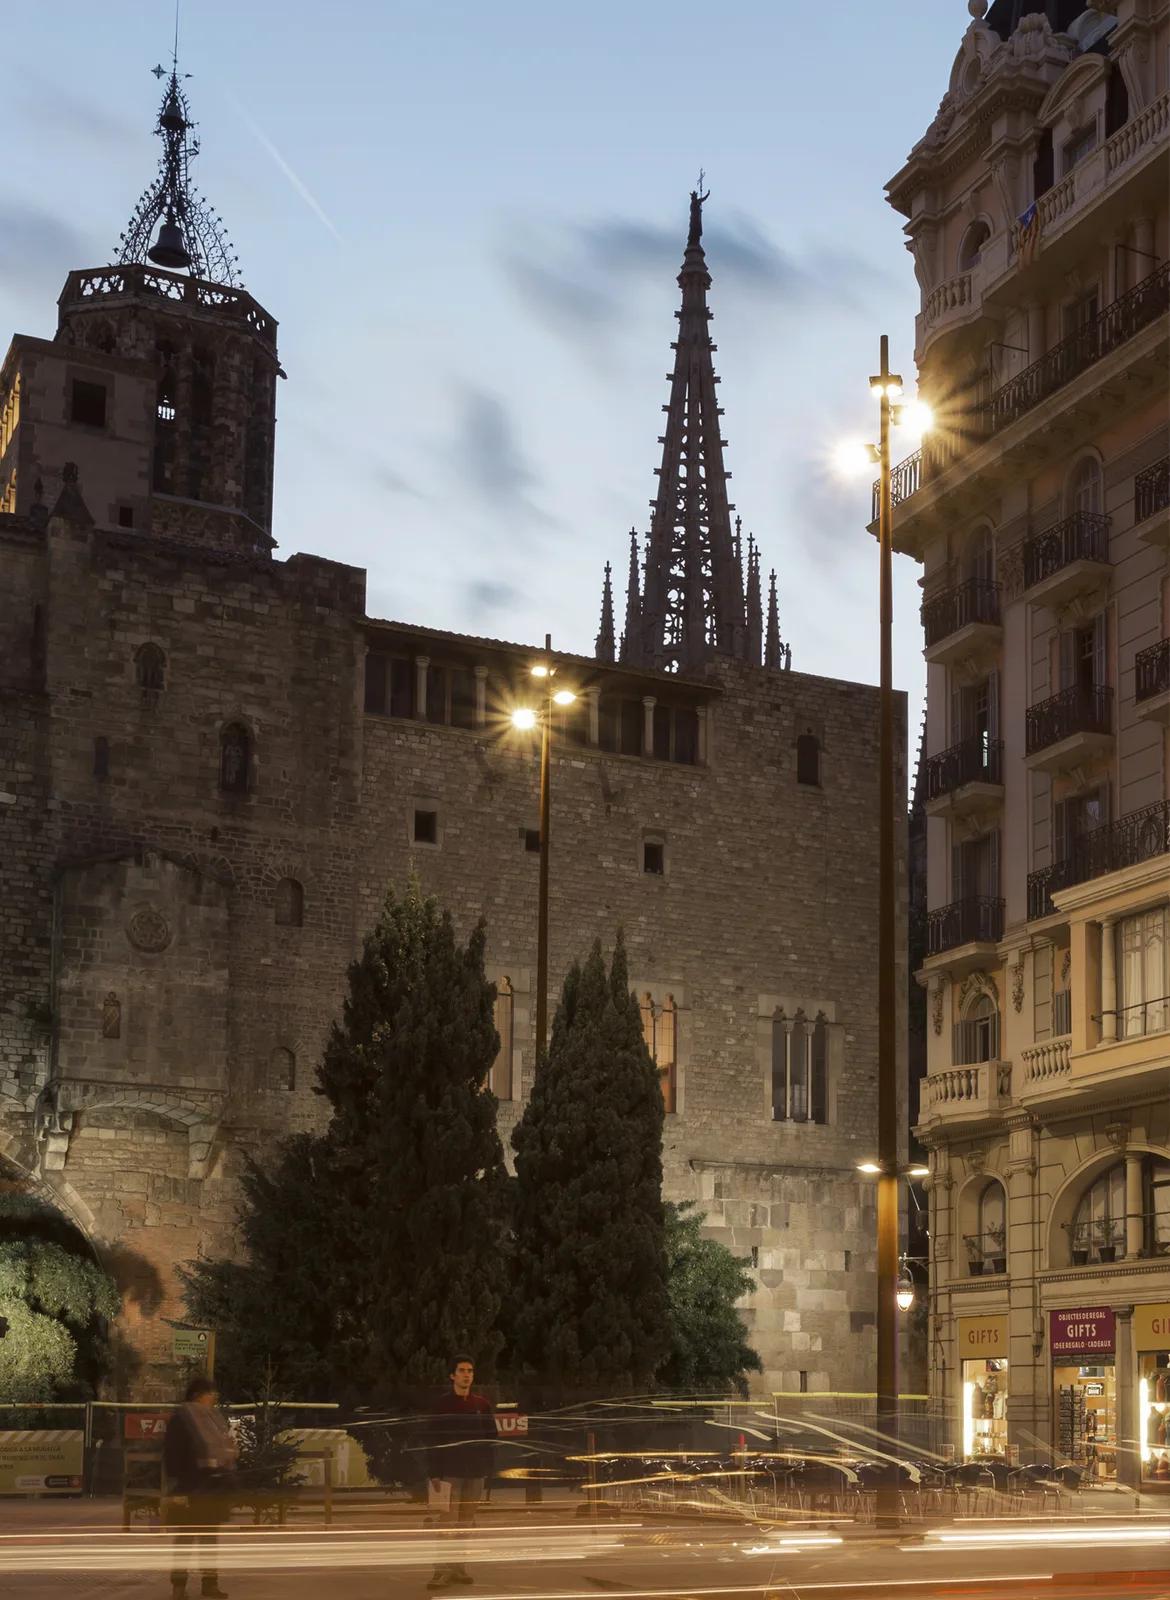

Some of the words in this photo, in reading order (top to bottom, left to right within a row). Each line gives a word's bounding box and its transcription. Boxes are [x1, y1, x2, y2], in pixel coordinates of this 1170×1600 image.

[968, 1329, 998, 1345] GIFTS
[1067, 1323, 1096, 1338] GIFTS
[1087, 1340, 1111, 1348] CADEAUX
[140, 1419, 167, 1433] FA
